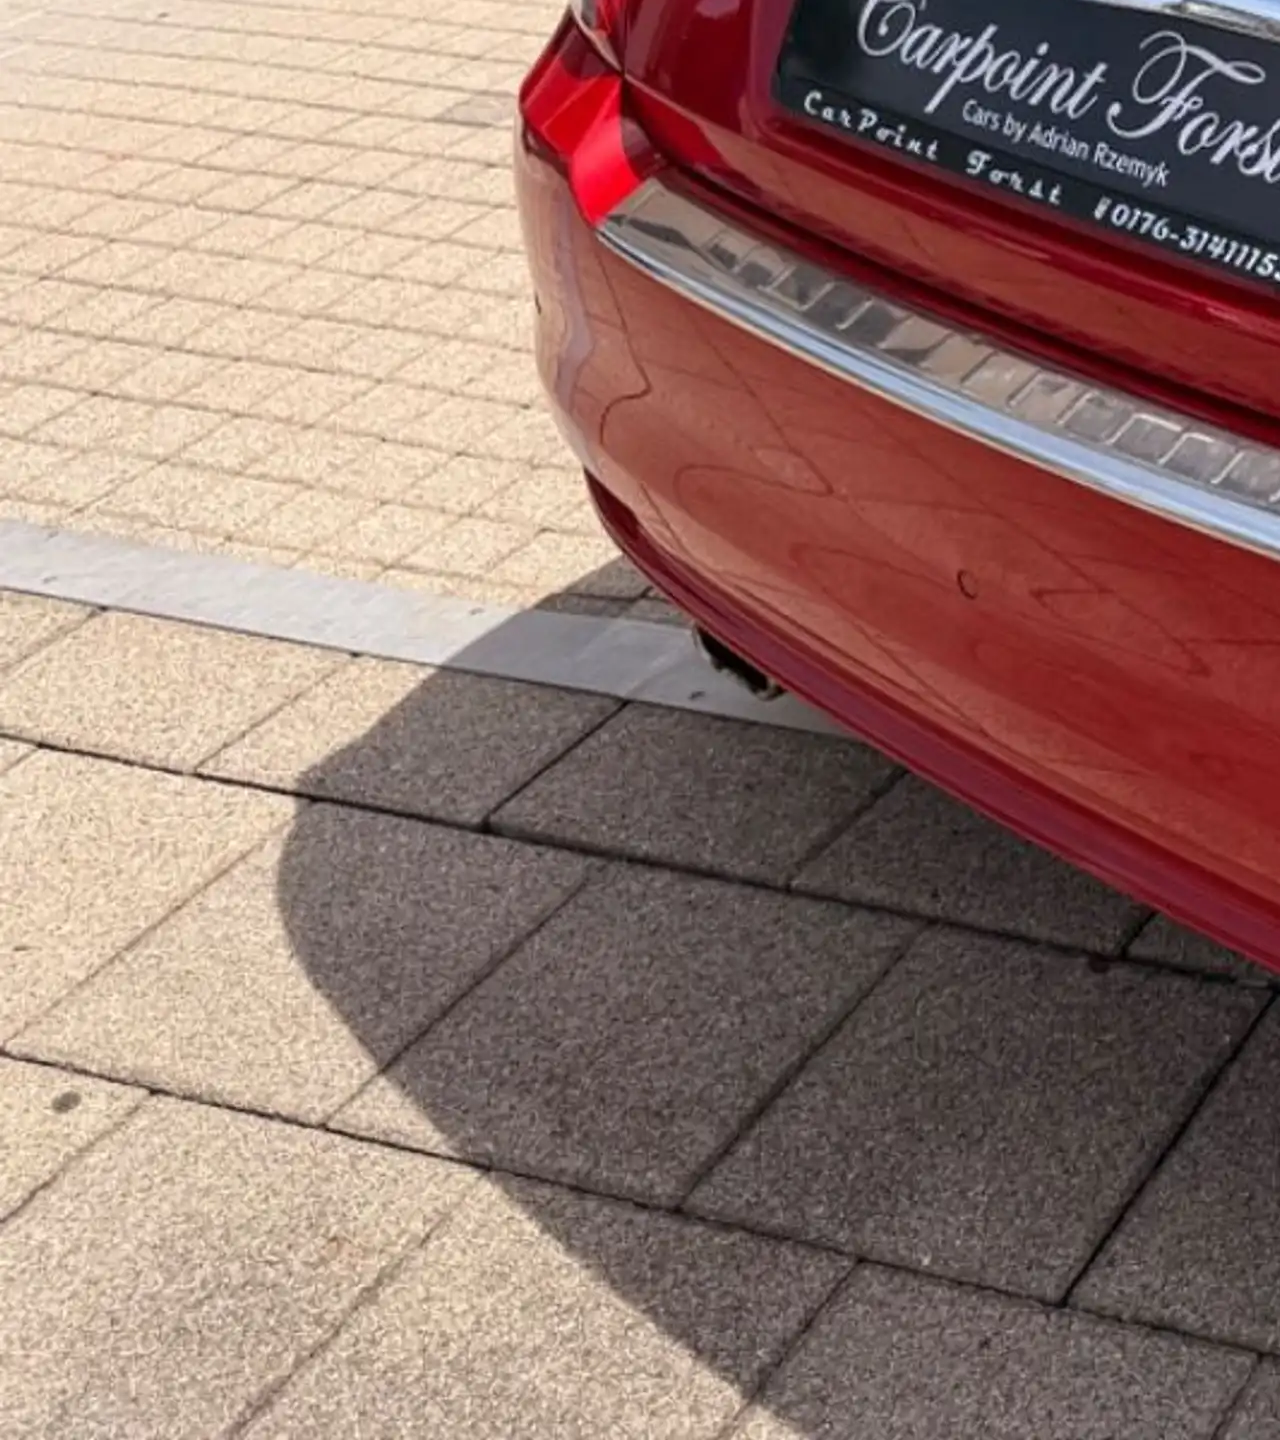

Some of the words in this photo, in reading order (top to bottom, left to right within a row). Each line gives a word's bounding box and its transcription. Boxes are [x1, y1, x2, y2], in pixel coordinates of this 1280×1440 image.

[803, 89, 940, 162] CarPoint
[965, 149, 1063, 206] Forst
[962, 98, 1001, 132] Cars
[1002, 112, 1028, 144] by
[1027, 120, 1092, 162] Adrian
[1093, 140, 1171, 188] Rzemyk
